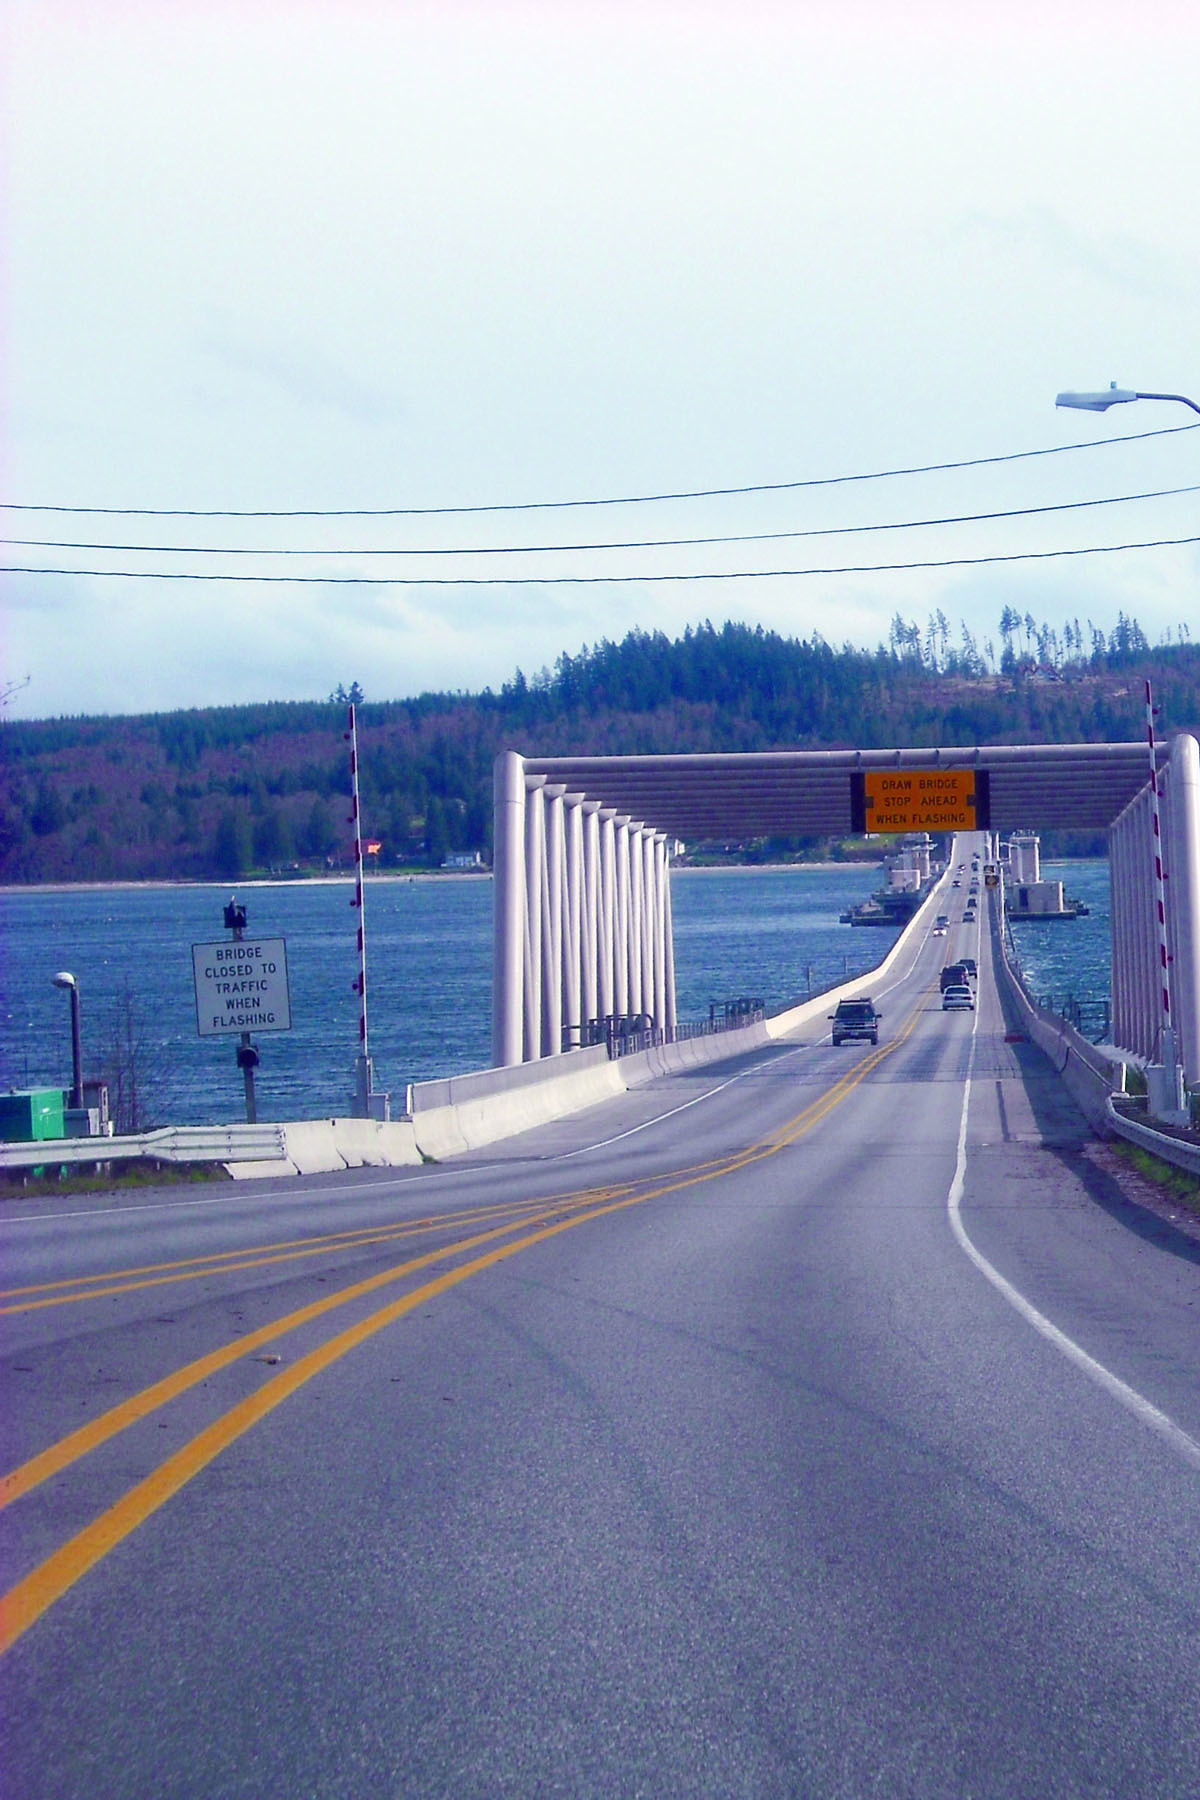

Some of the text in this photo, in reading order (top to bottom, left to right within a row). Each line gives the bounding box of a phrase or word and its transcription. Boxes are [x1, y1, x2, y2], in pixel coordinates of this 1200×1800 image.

[882, 779, 958, 790] DRAW BRIDGE
[884, 795, 957, 807] STOP AHEAD
[876, 813, 965, 824] WHEN FLASHING
[216, 947, 262, 961] BRIDGE
[205, 963, 276, 979] CLOSED TO
[216, 980, 268, 994] TRAFFIC
[226, 997, 260, 1010] WHEN
[213, 1013, 276, 1028] FLASHING
